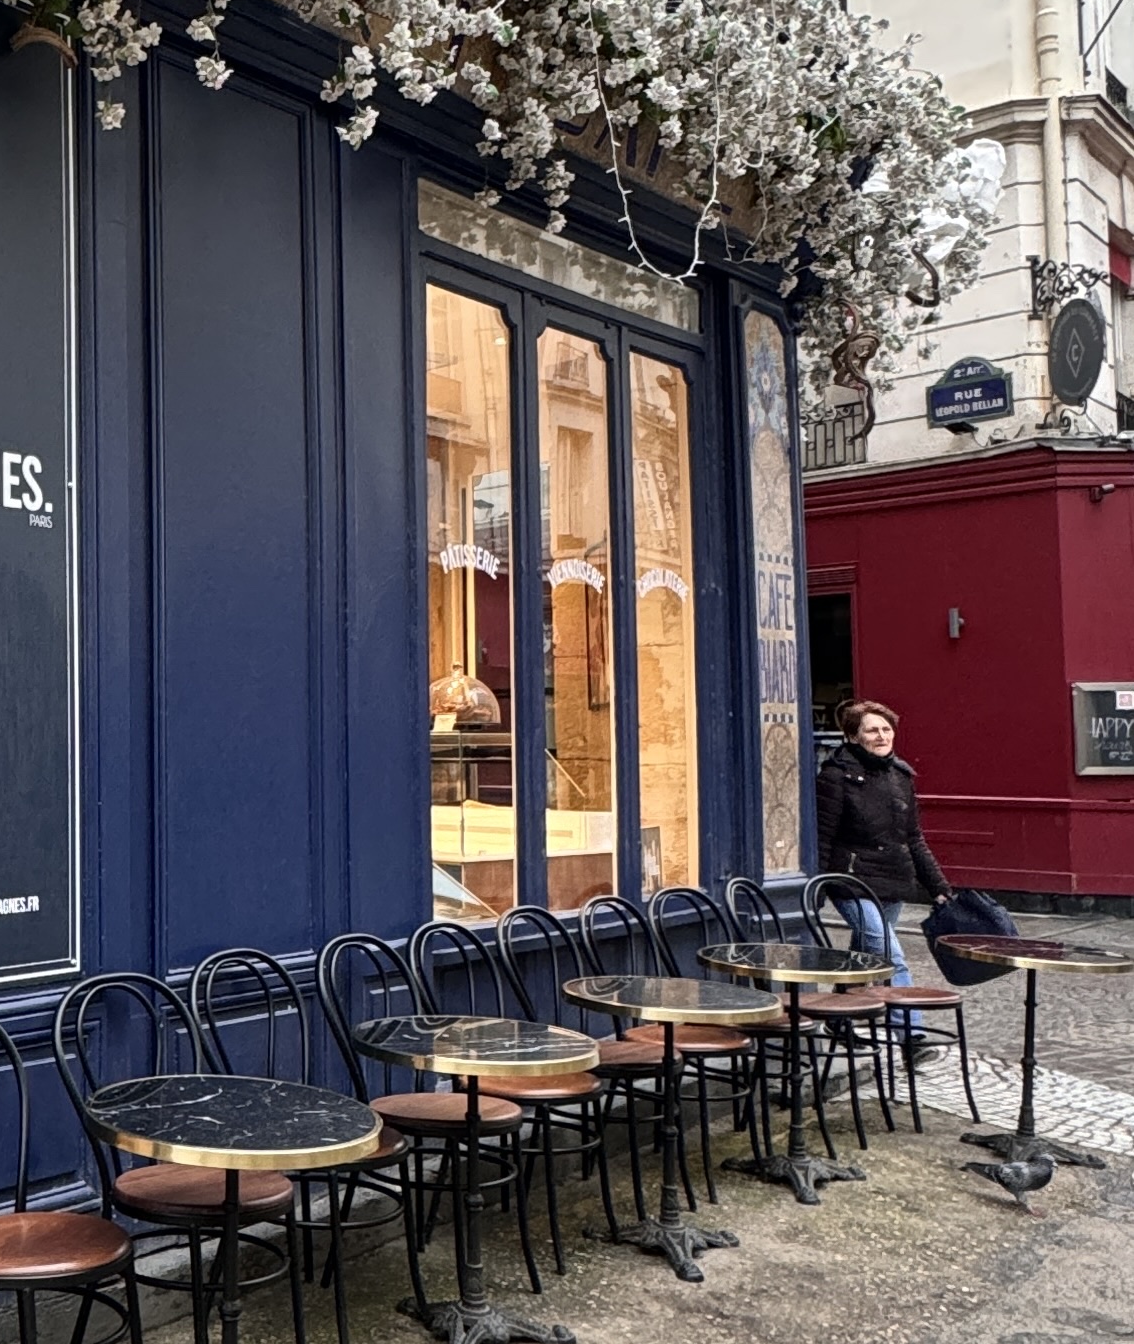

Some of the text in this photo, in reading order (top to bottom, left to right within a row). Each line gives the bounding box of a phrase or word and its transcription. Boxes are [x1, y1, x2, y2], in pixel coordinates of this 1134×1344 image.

[954, 387, 983, 401] RUE
[972, 397, 1004, 411] BELLAN
[28, 513, 54, 529] PARIS
[758, 570, 793, 631] CAFE
